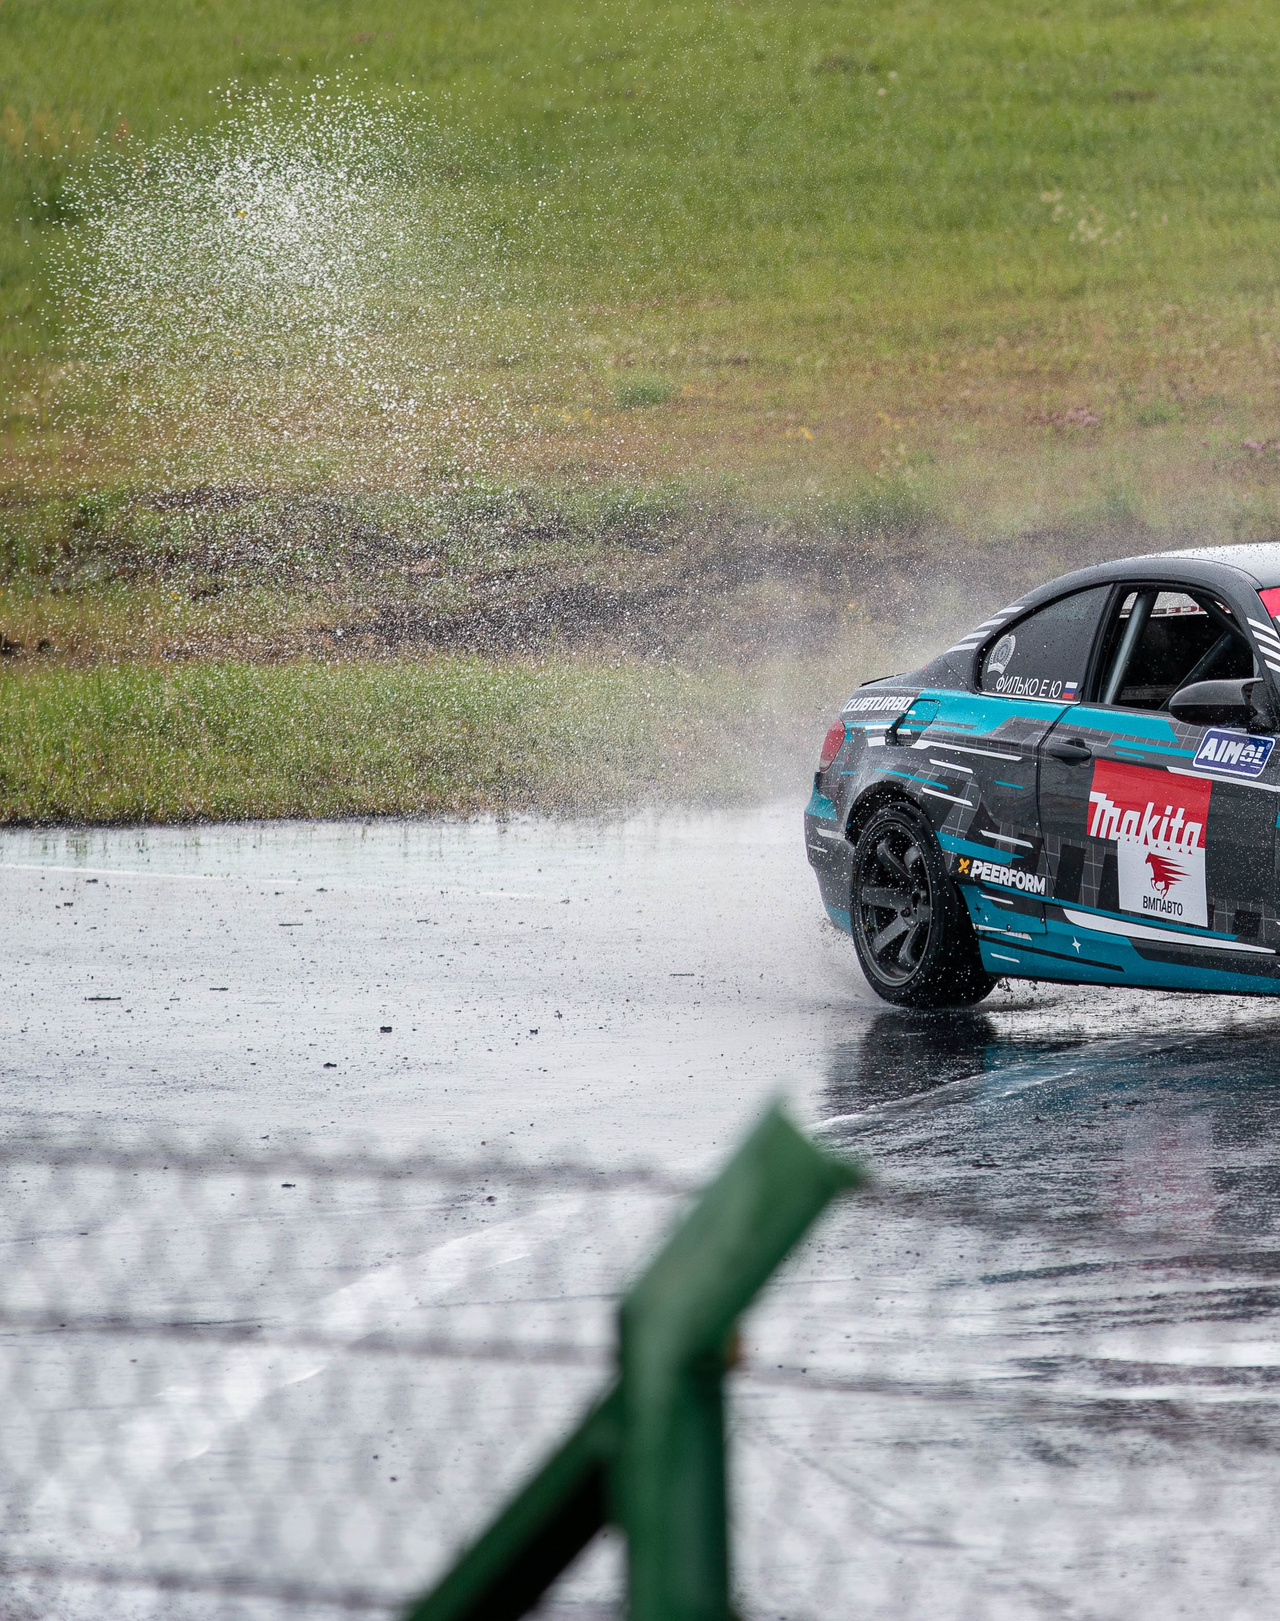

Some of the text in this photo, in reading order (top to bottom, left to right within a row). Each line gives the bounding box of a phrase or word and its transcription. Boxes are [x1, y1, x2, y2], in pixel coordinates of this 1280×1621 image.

[996, 675, 1062, 698] ФИЛЬКО Е Ю
[1198, 738, 1267, 769] AIMOL
[1143, 895, 1183, 916] ВМПАВТО
